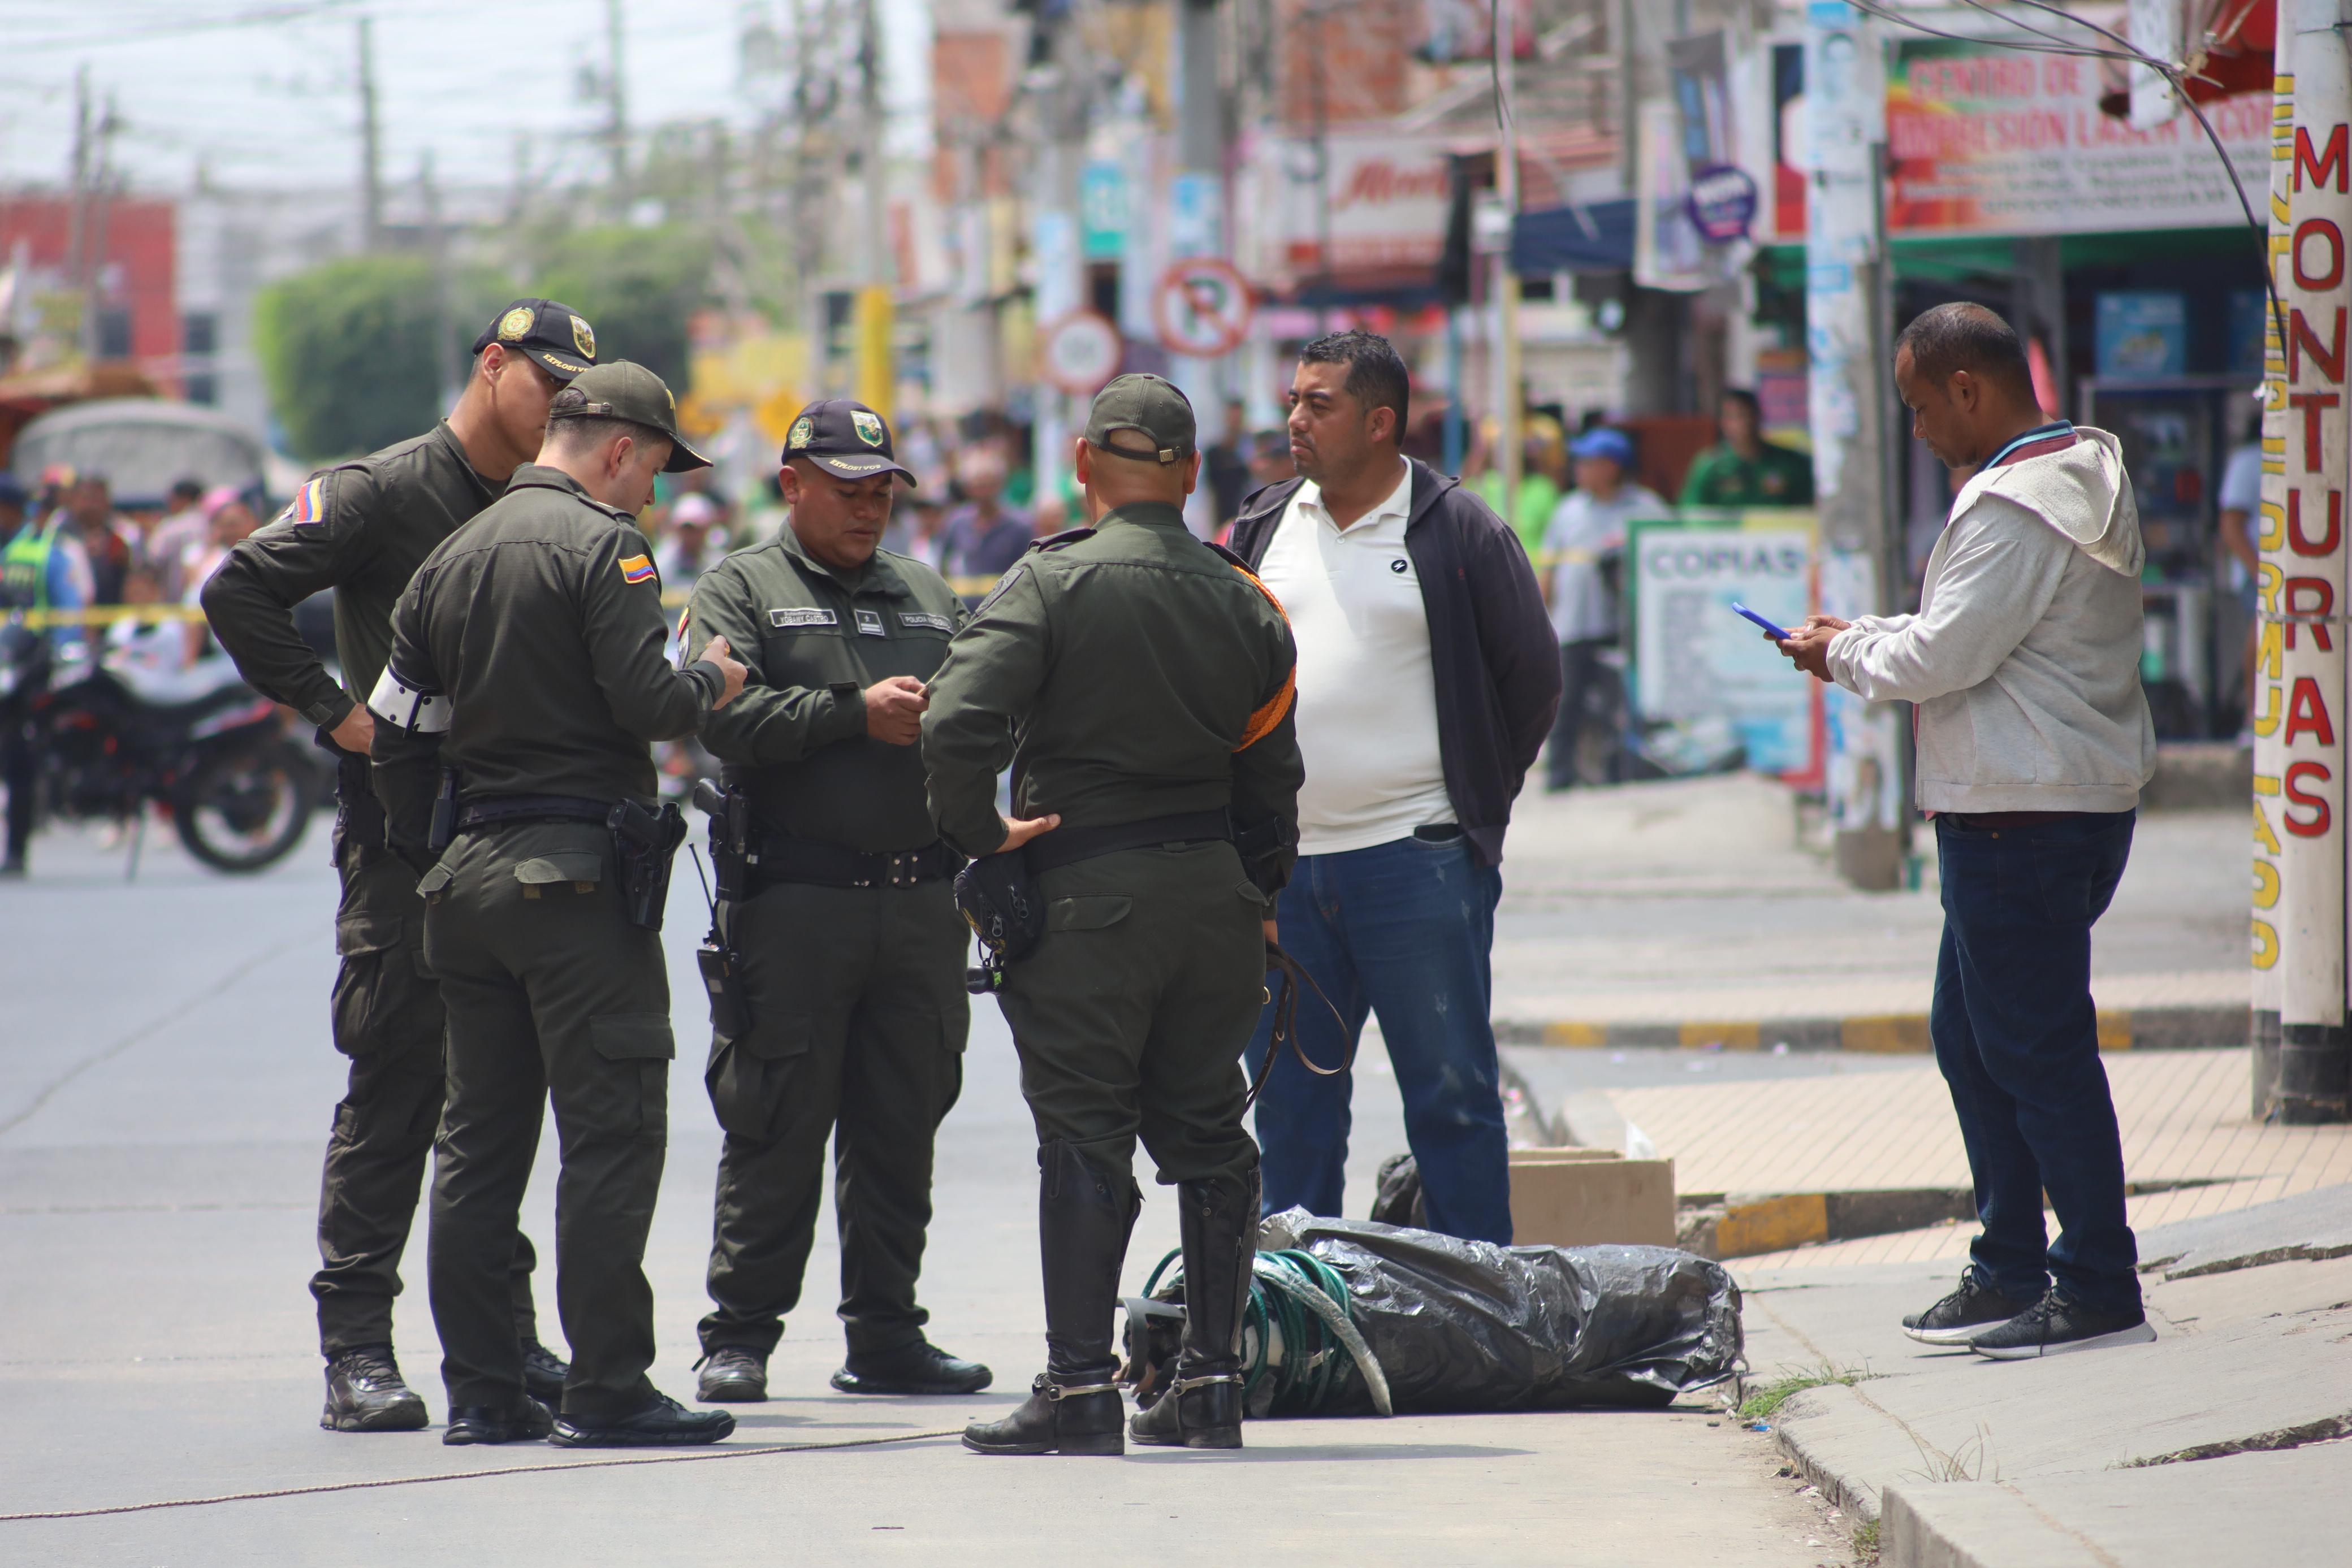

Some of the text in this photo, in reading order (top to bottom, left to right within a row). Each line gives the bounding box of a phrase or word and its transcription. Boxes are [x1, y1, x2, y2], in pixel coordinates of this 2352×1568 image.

[1909, 57, 2086, 102] CENTRO DE
[543, 353, 590, 372] EXPLOSIV
[829, 459, 881, 471] EXPLOSIVOS
[2284, 123, 2349, 838] MONTURAS
[1648, 544, 1802, 580] COPIAS
